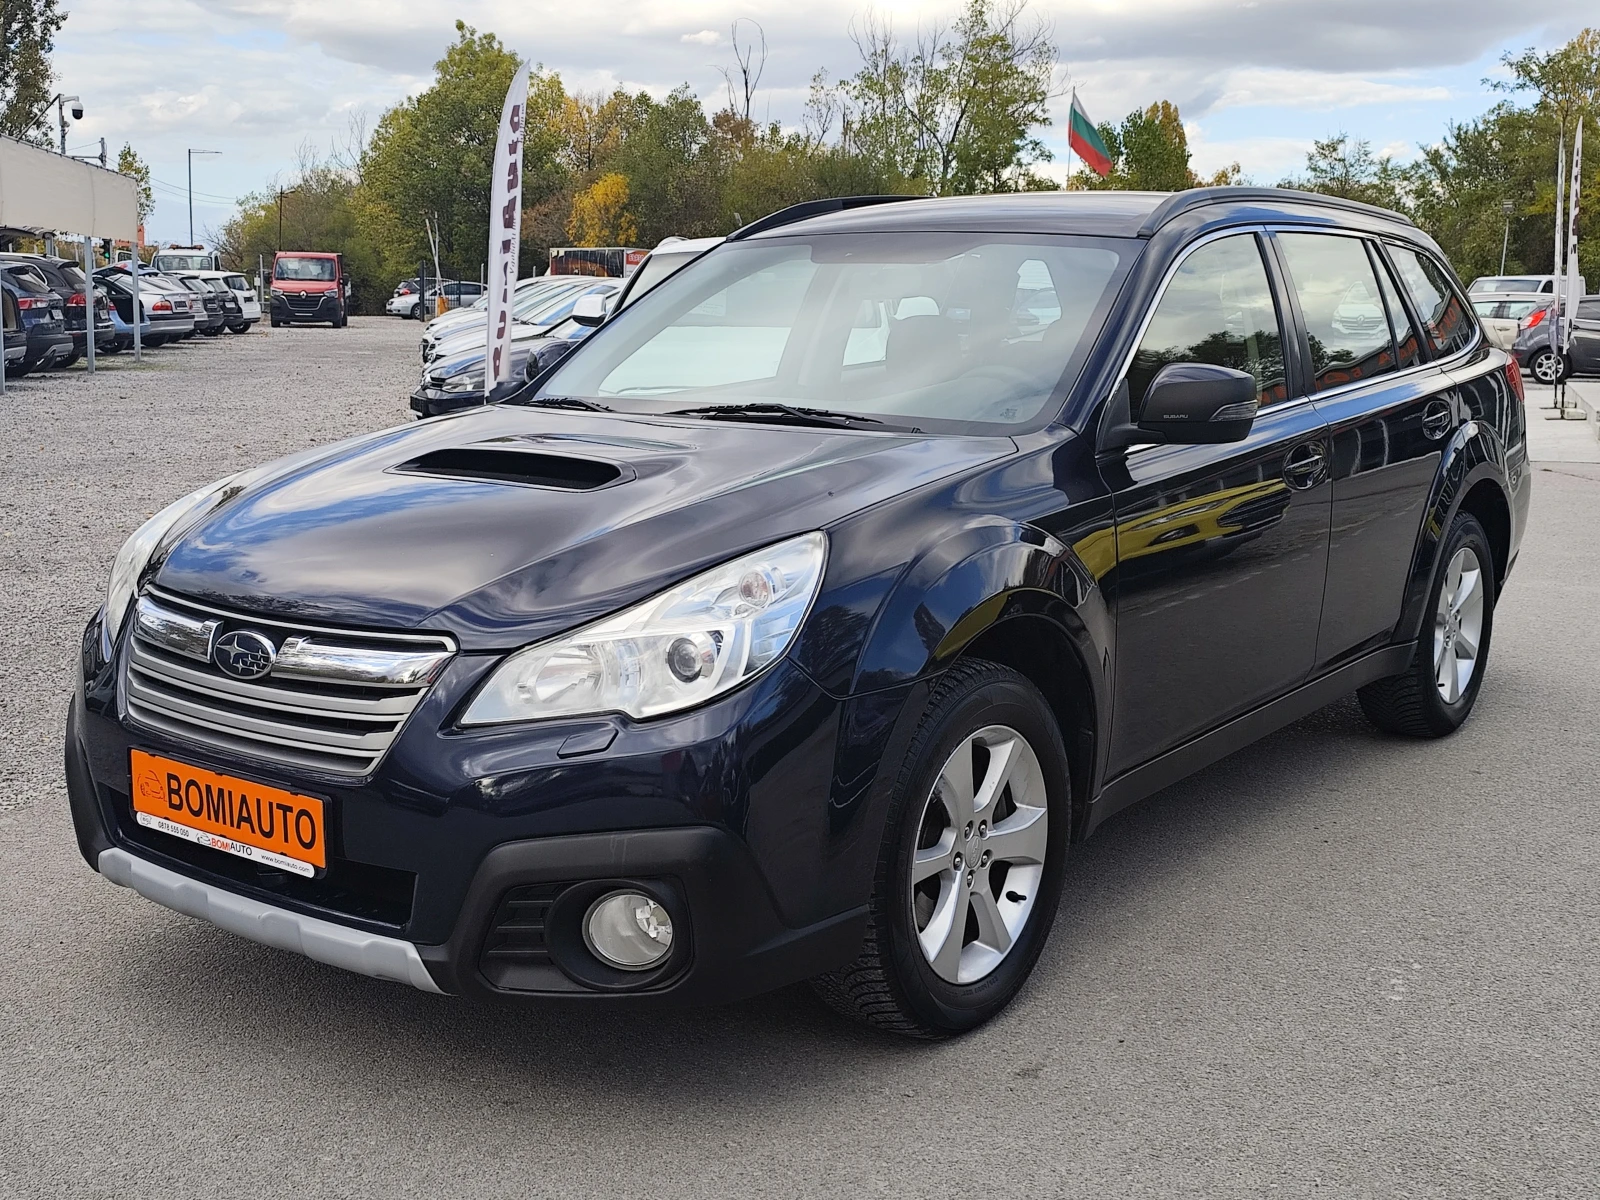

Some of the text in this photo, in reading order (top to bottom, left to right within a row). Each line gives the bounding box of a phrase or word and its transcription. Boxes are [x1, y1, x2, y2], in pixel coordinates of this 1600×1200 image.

[166, 772, 317, 850] BOMIAUTO
[171, 825, 180, 834] 555
[211, 837, 253, 856] BOMIAUTO
[261, 854, 311, 873] www.bomiauto.com
